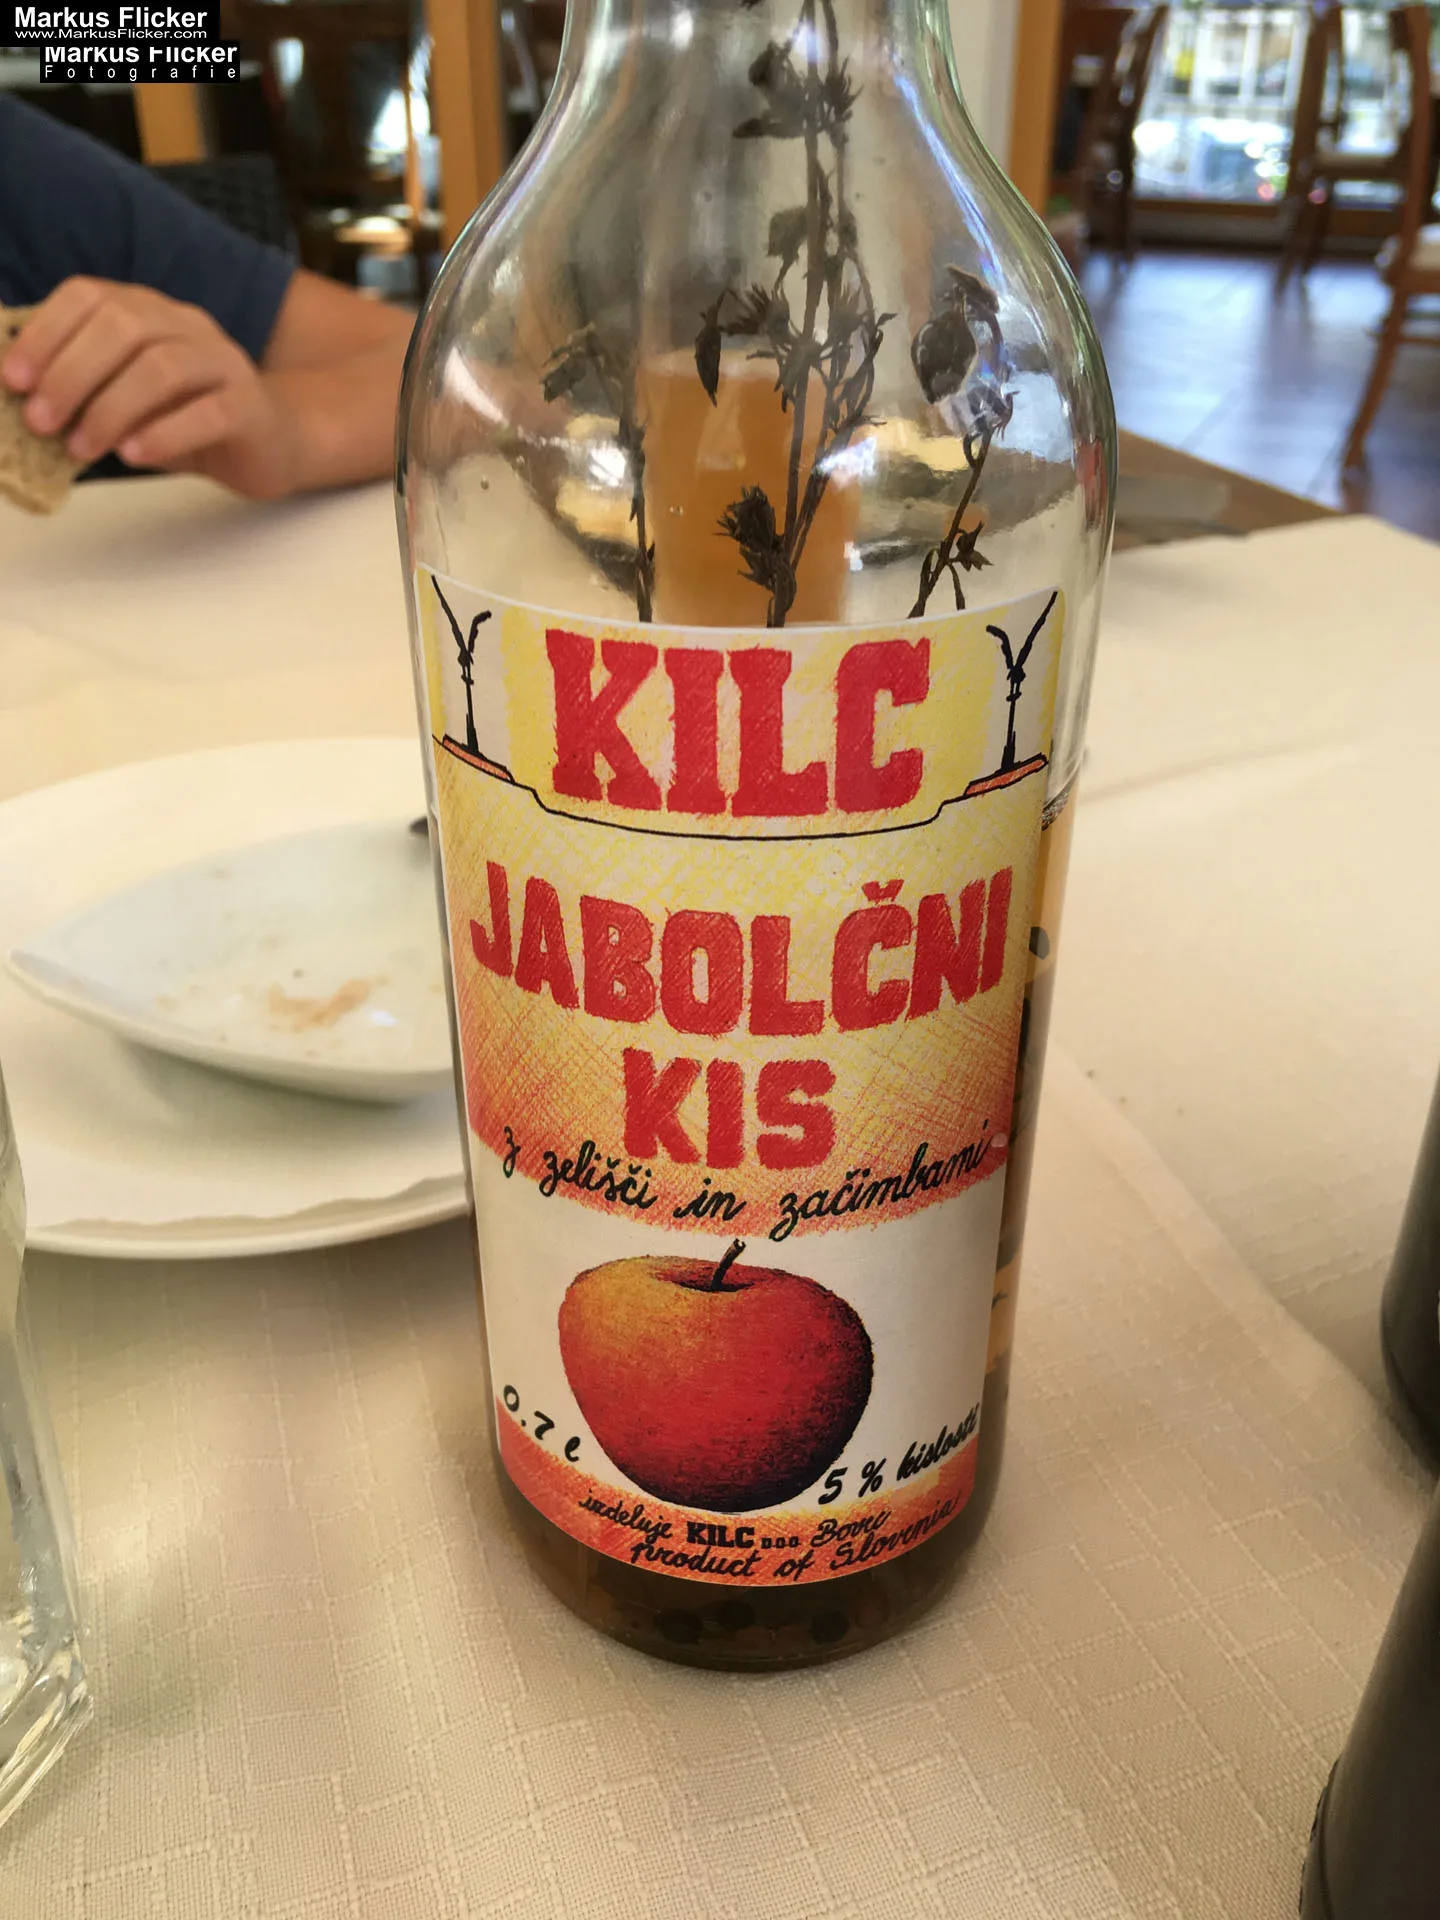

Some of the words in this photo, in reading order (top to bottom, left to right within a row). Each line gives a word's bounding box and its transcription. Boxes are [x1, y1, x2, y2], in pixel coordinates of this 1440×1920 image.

[545, 627, 931, 818] KILC
[470, 860, 1012, 1037] JABOLČNI
[622, 1047, 837, 1169] KIS
[503, 1126, 521, 1178] z
[539, 1140, 659, 1209] zelišči
[673, 1177, 747, 1221] in
[768, 1119, 993, 1243] začimbami
[503, 1384, 555, 1440] 0.7
[818, 1467, 848, 1505] 5
[858, 1457, 886, 1498] %
[630, 1541, 762, 1577] product
[773, 1549, 815, 1580] of
[687, 1521, 755, 1549] KILC
